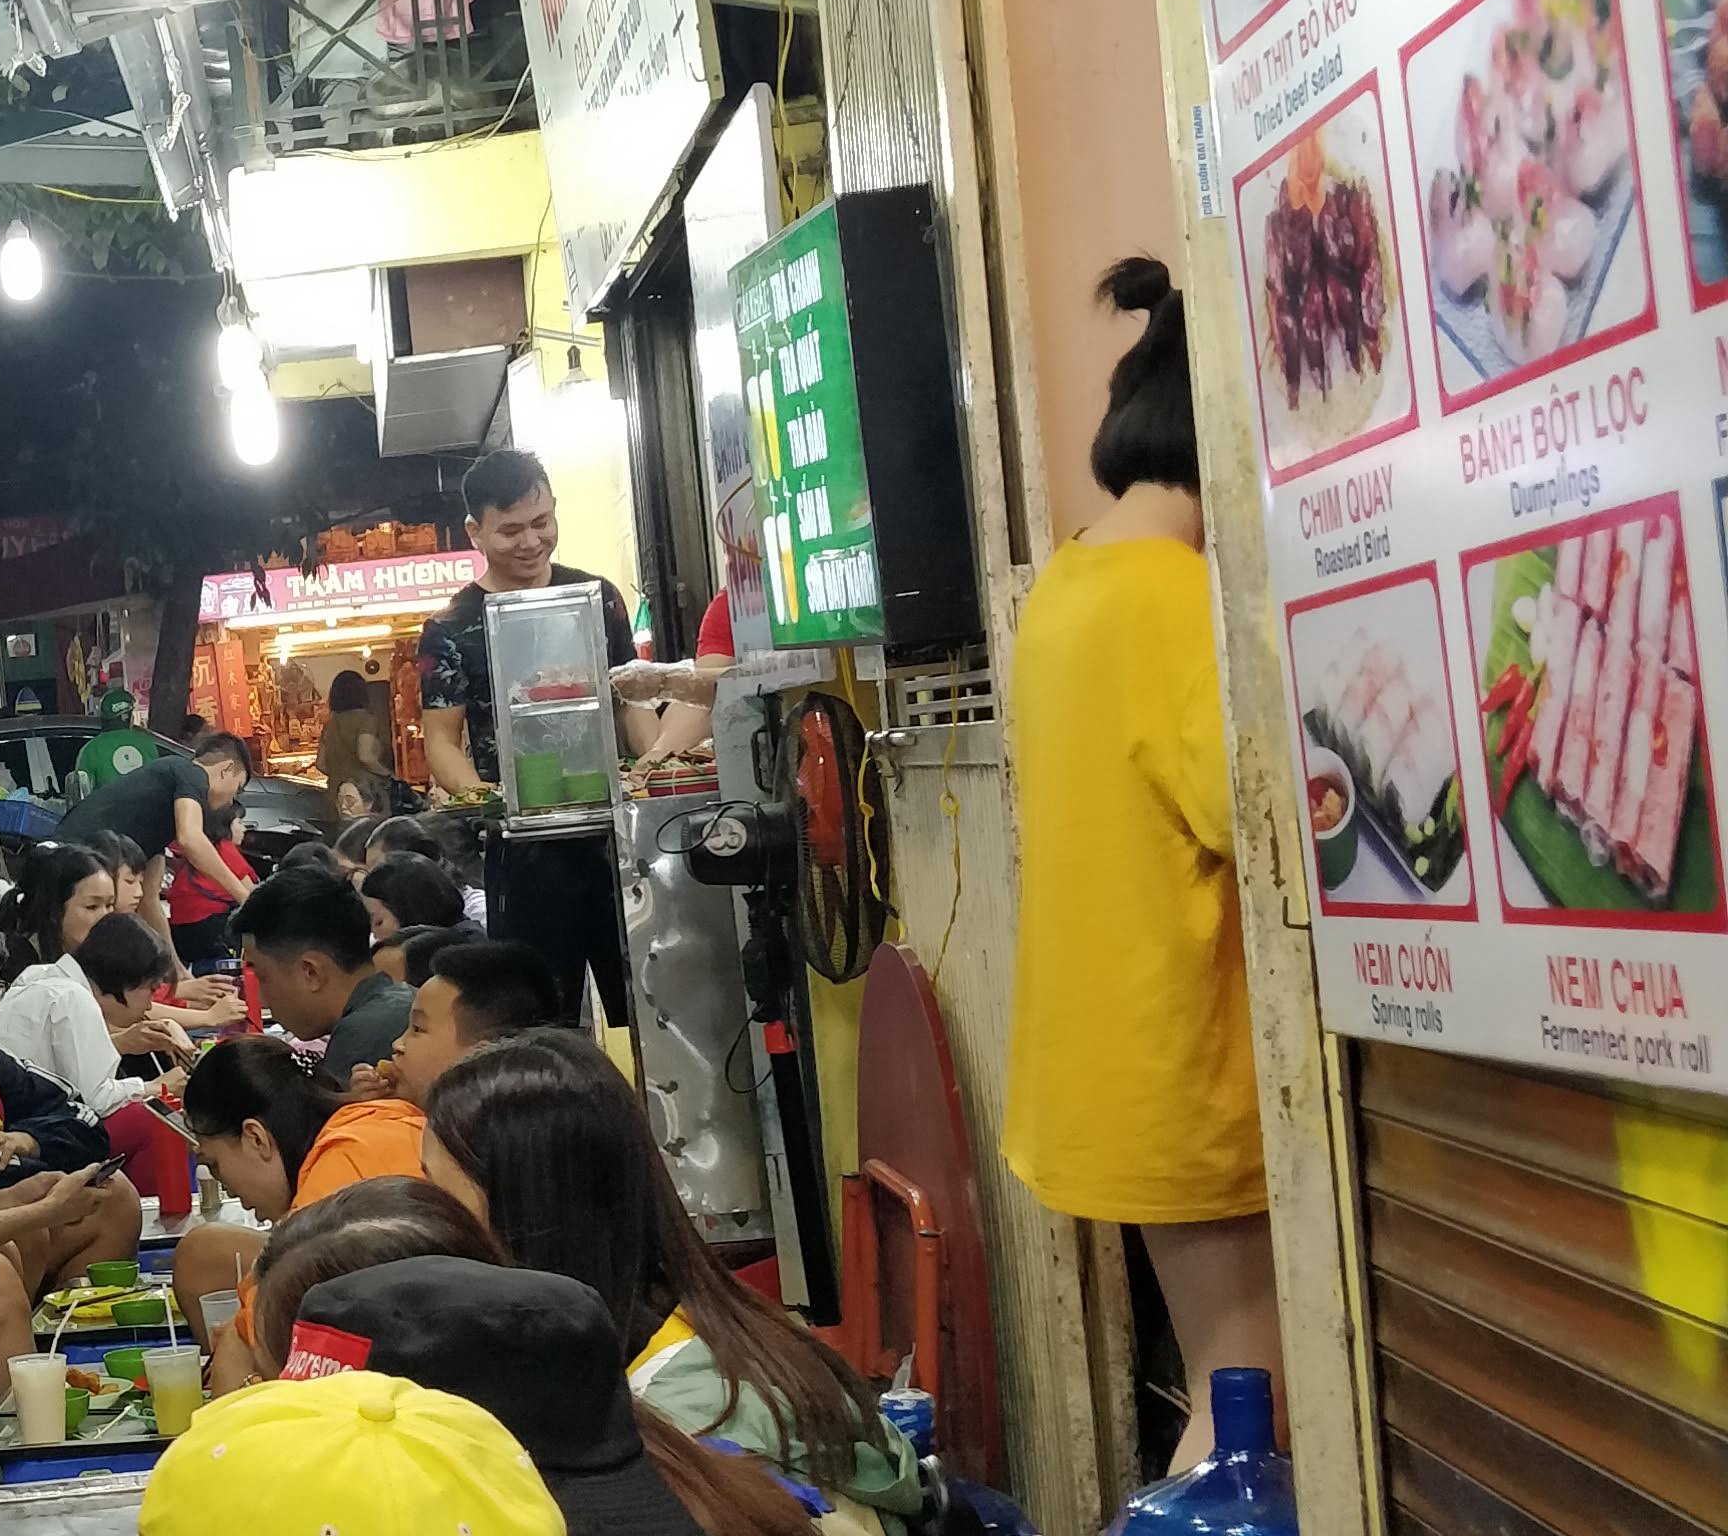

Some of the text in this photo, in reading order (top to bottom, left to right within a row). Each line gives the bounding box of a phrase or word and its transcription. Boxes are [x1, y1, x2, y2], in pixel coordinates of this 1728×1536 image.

[1253, 44, 1344, 143] Dried beef salad
[787, 248, 823, 314] CHANH
[1458, 420, 1525, 486] BÁNH
[1532, 394, 1580, 464] BỘT
[1592, 364, 1649, 452] LỌC
[1298, 464, 1396, 544] CHIM QUAY
[1510, 462, 1602, 520] Dumplings
[372, 557, 475, 592] HƯƠNG
[1314, 538, 1393, 580] Roasted Bird
[1354, 924, 1455, 996] NEM CUỐN
[1546, 954, 1690, 1020] NEM CHUA
[1370, 994, 1444, 1036] Spring rolls
[1540, 1014, 1713, 1074] Fermented pork roll
